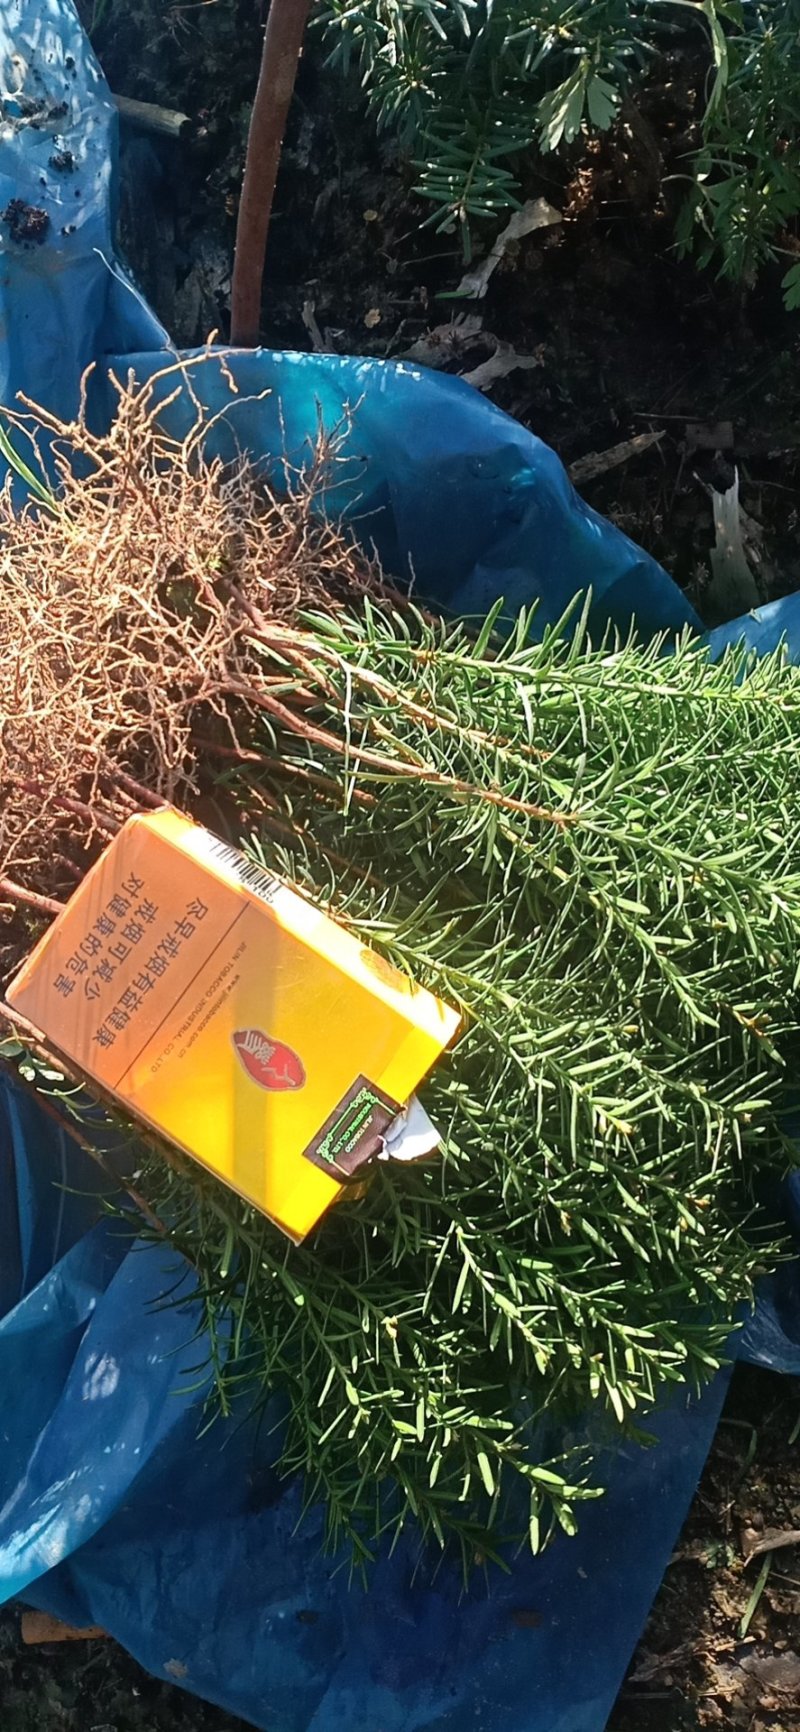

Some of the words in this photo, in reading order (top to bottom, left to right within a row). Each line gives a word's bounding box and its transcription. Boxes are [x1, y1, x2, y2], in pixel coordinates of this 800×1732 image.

[53, 872, 144, 998] 对健康的危害
[84, 898, 159, 1001] 戒烟可减少
[232, 941, 247, 961] JILIN
[92, 897, 208, 1050] 尽早戒烟有益健康
[205, 962, 234, 998] TOBACCO
[173, 998, 207, 1041] INDUSTRIAL
